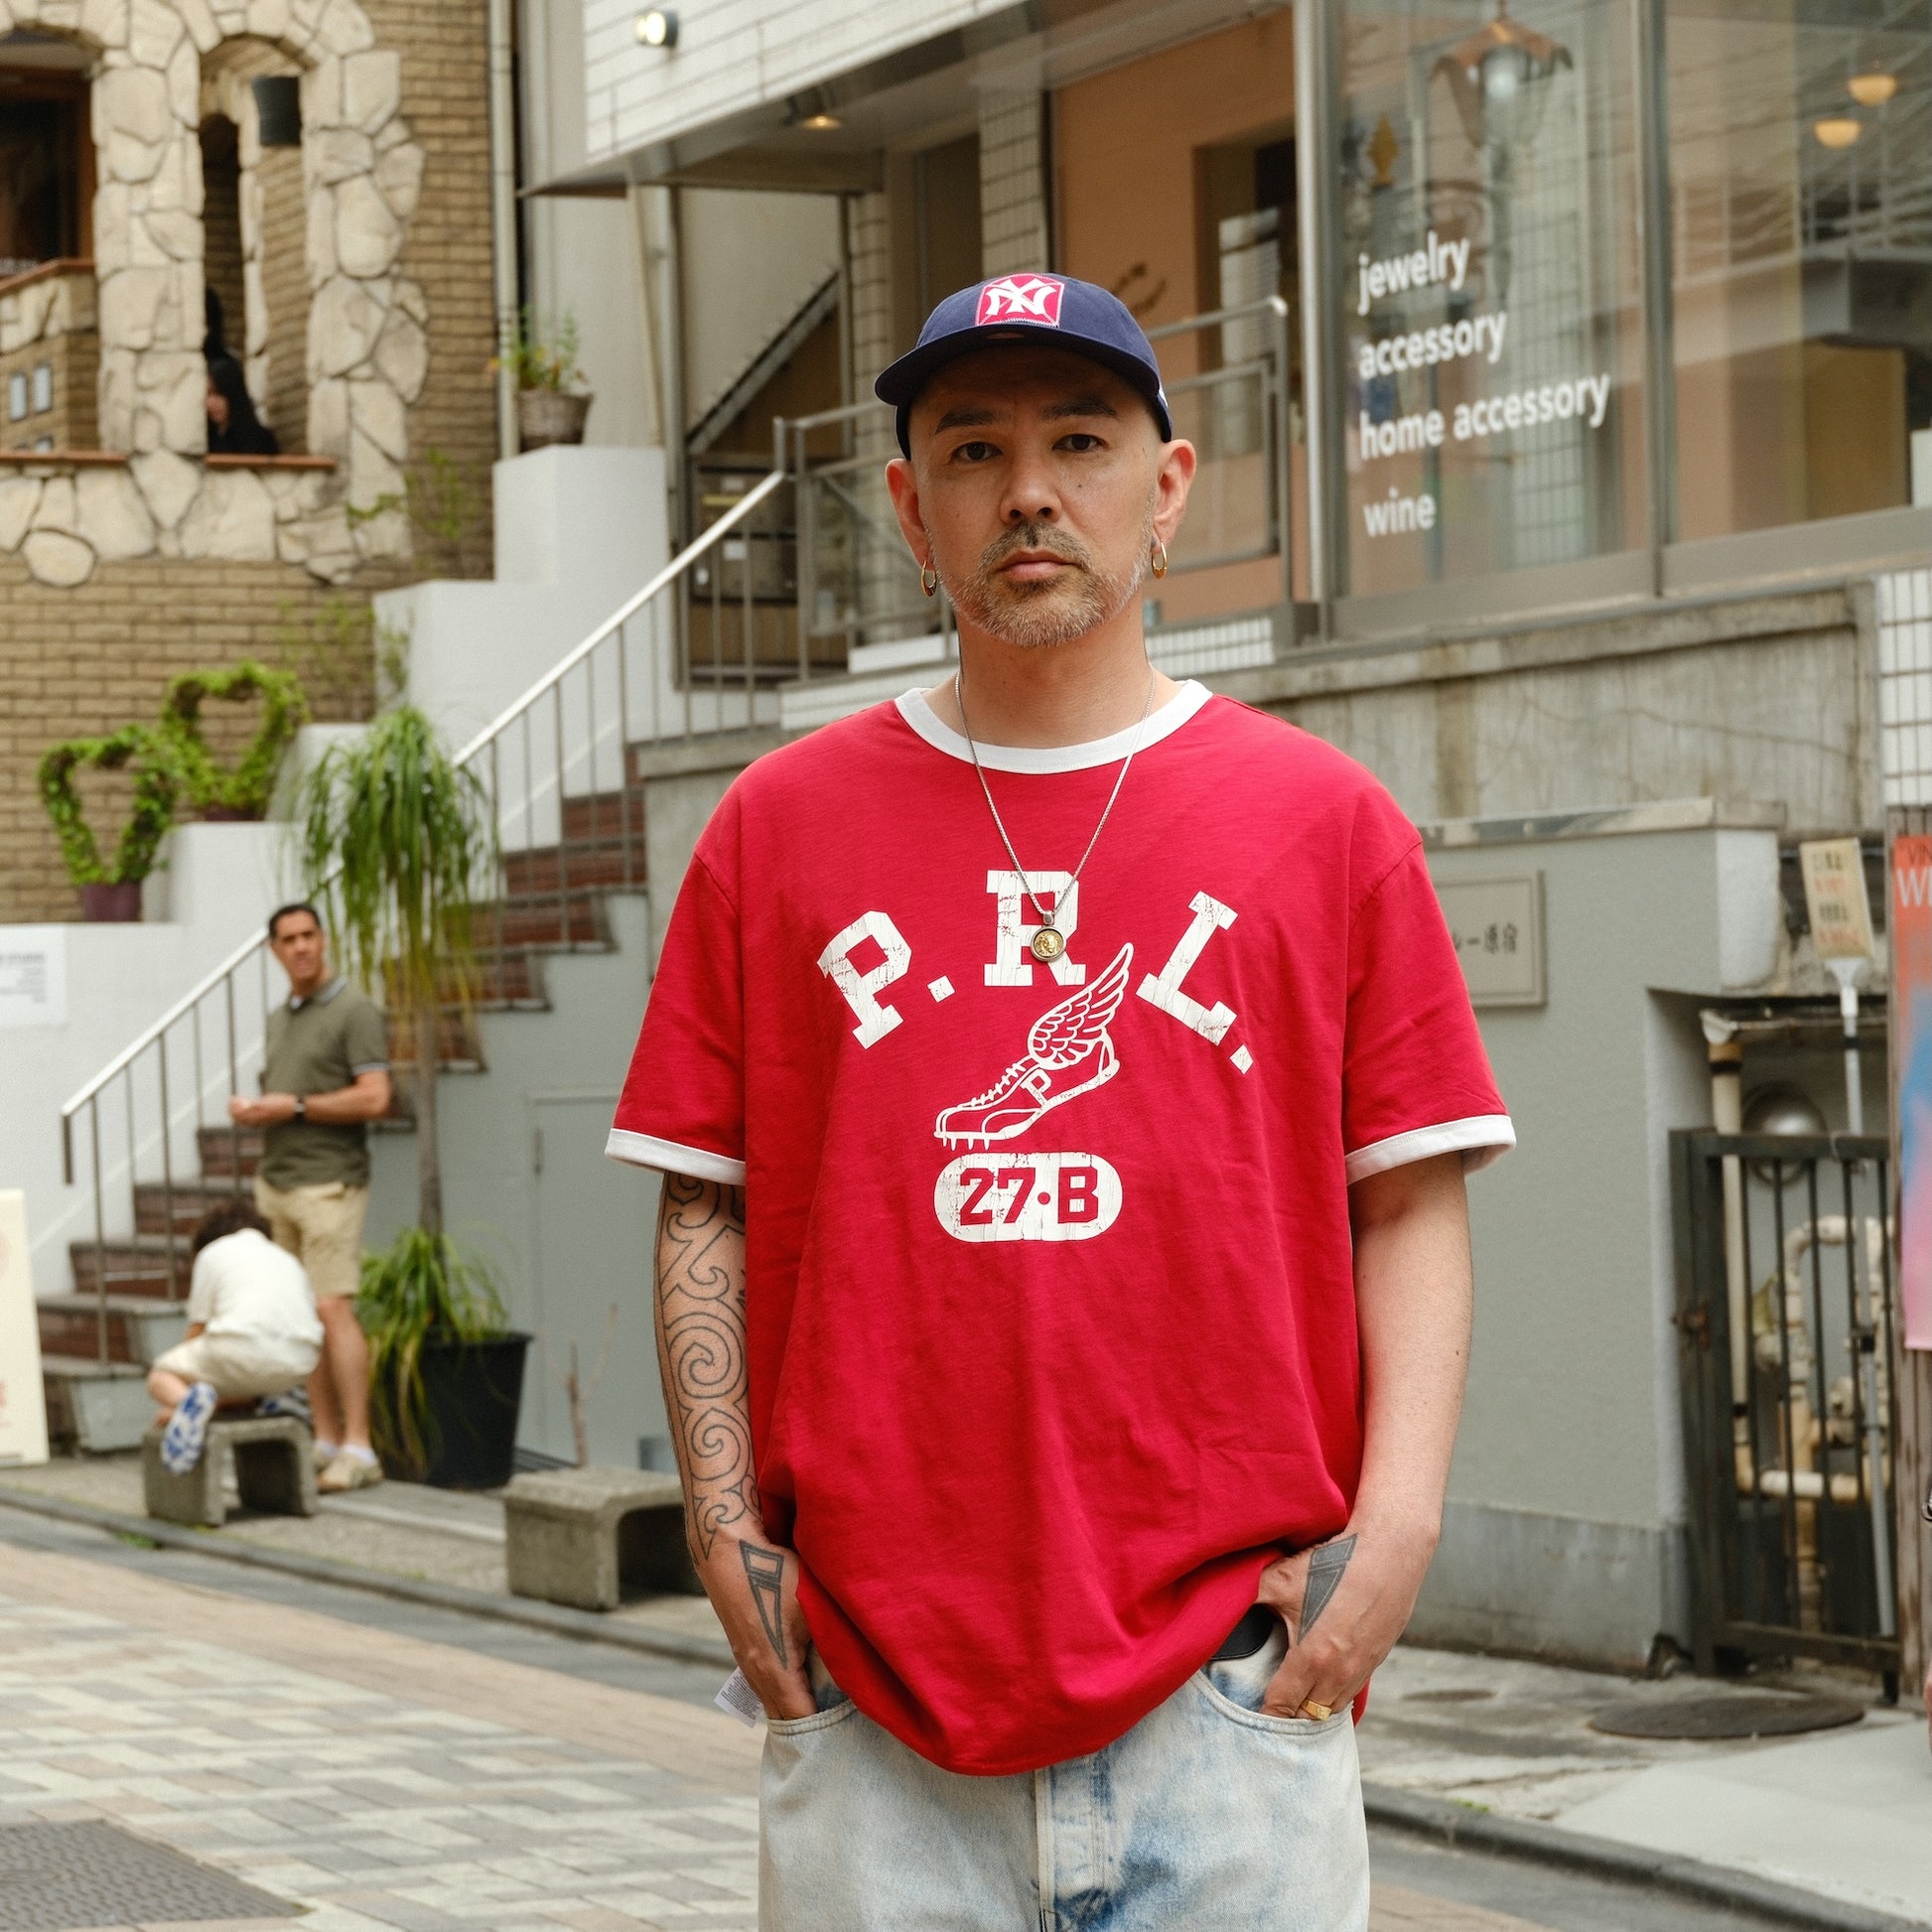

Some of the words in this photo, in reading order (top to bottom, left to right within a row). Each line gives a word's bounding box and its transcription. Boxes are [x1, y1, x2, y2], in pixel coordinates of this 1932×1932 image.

[1358, 230, 1470, 315] jewelry
[1358, 311, 1507, 380] accessory
[1360, 410, 1445, 461] home
[1452, 373, 1610, 441] accessory
[1363, 486, 1436, 537] wine
